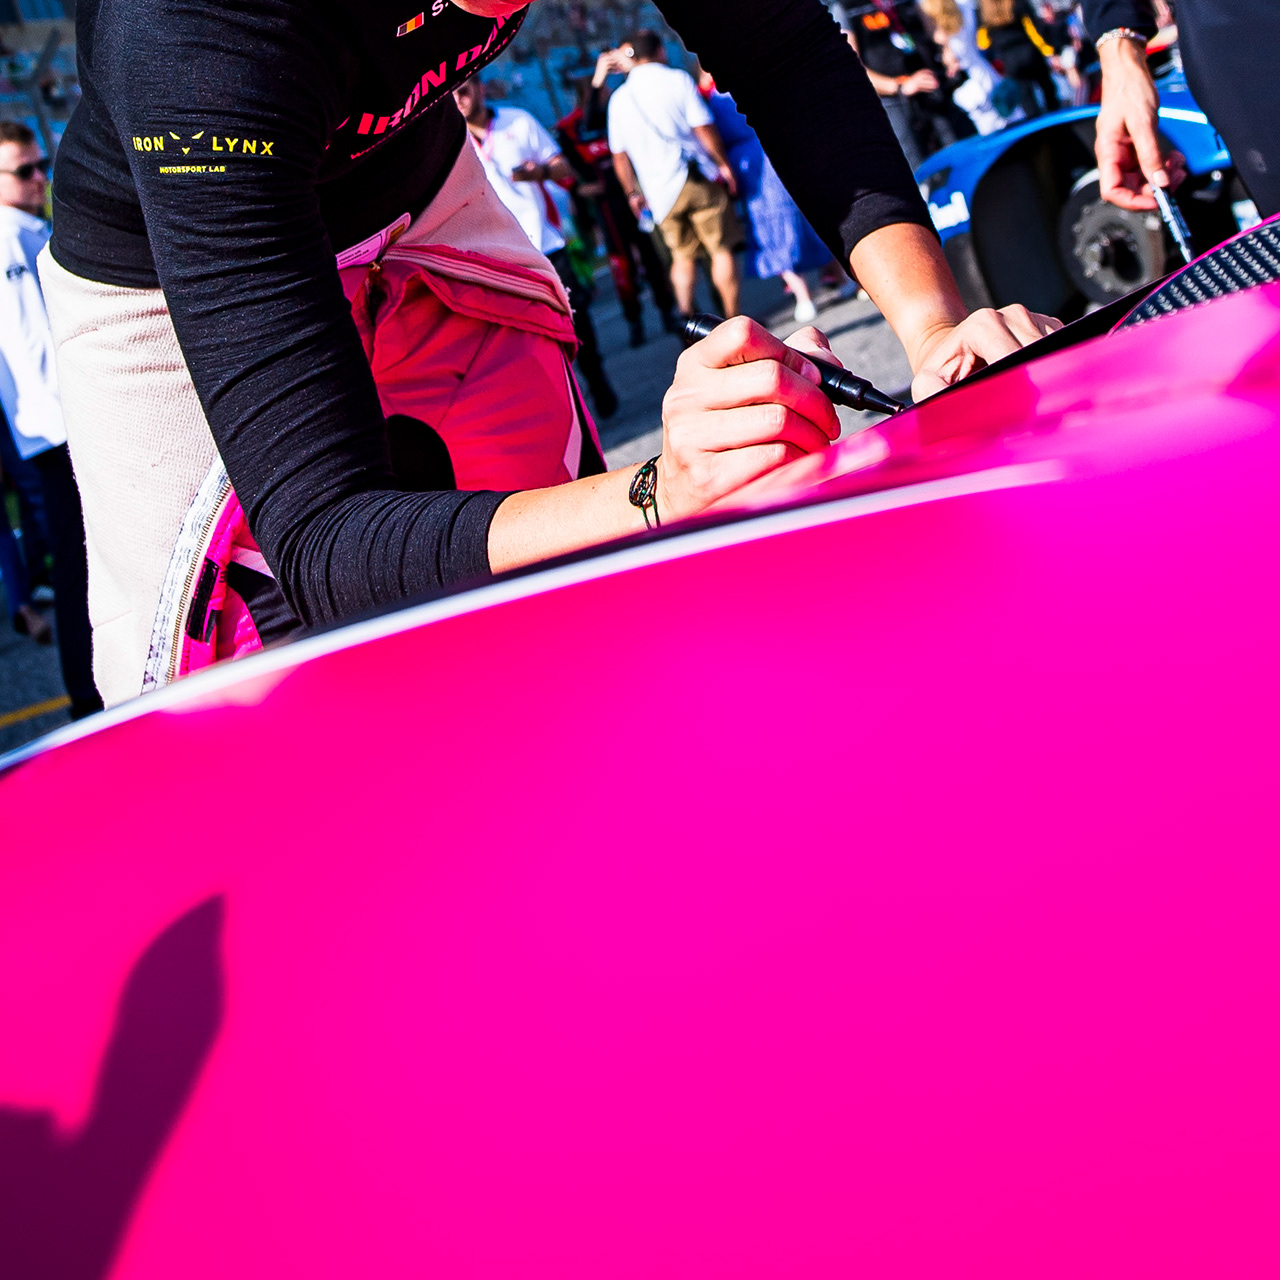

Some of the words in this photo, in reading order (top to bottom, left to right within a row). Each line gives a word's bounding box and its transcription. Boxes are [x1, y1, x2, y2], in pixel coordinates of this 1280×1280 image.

[132, 136, 165, 152] IRON
[212, 136, 275, 156] LYNX
[159, 166, 207, 174] MOTORSPORT
